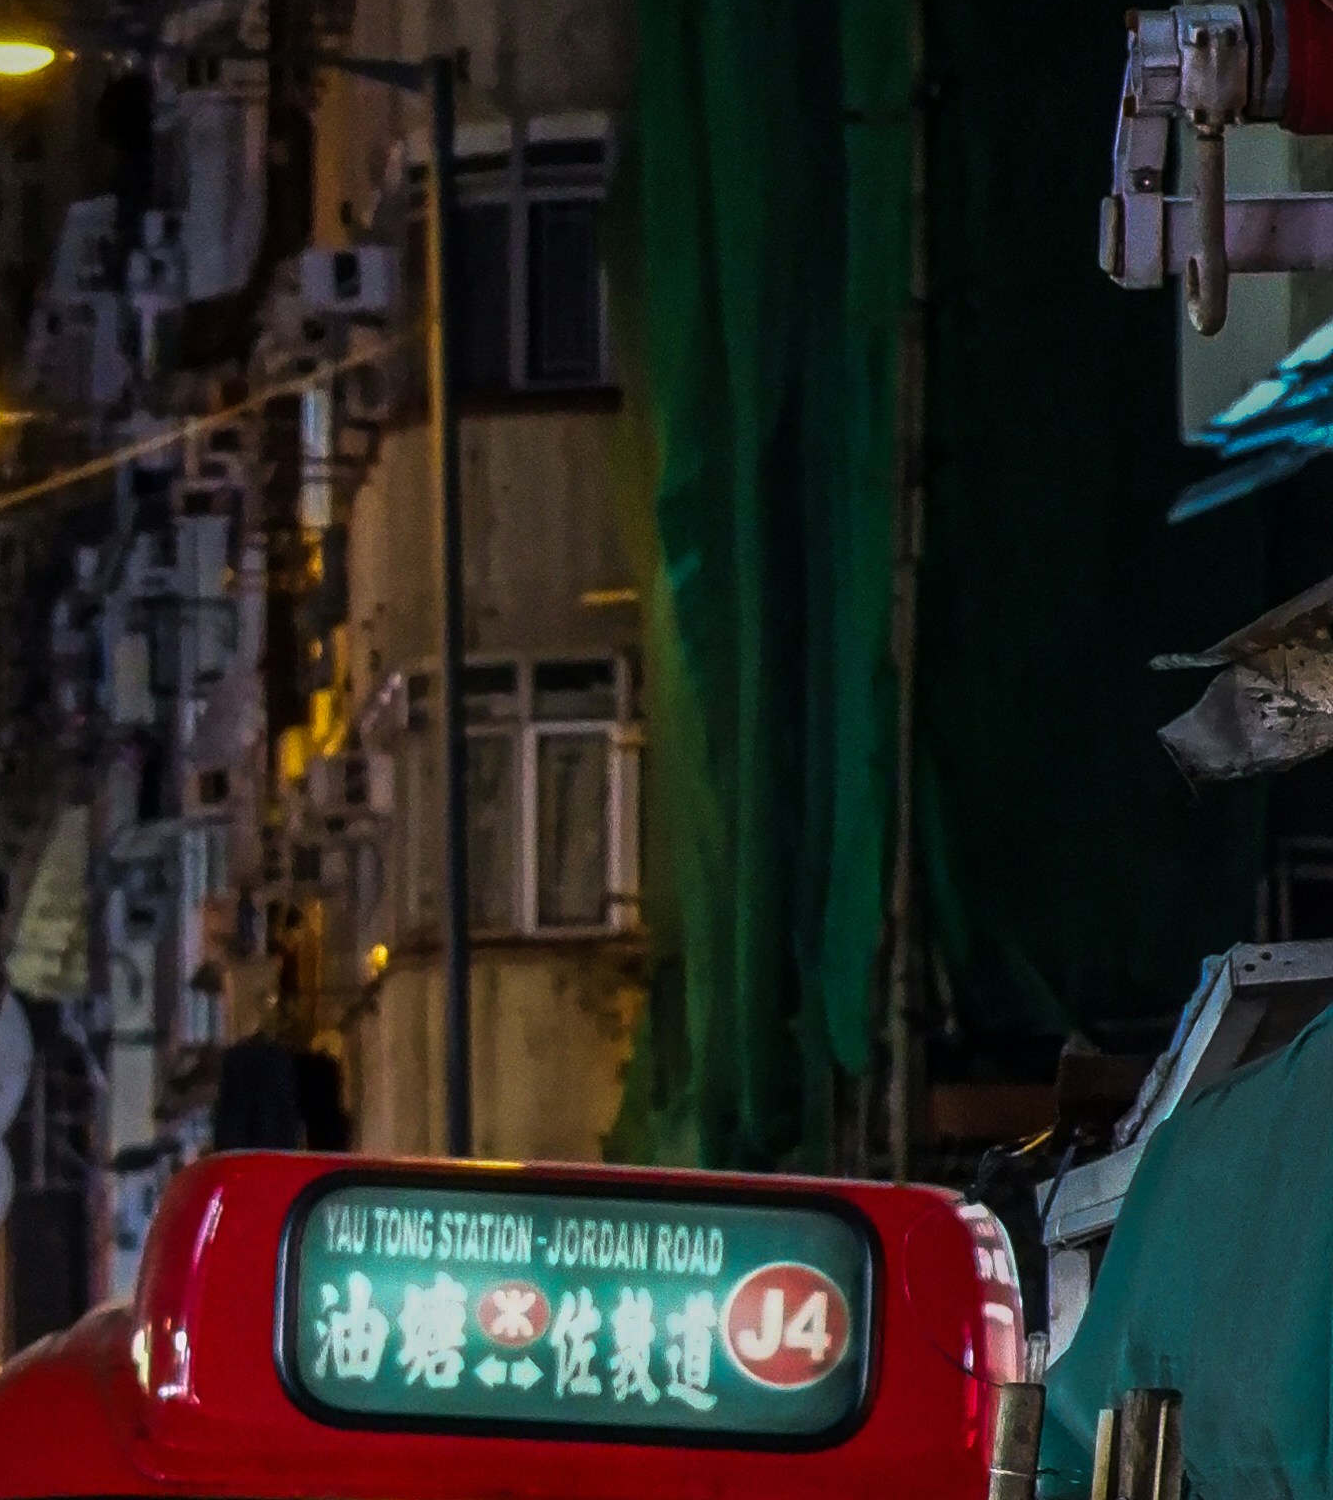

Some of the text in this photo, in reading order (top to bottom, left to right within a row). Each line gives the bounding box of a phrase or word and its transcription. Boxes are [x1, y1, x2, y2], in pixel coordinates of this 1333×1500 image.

[326, 1206, 367, 1254] YAU
[373, 1206, 434, 1259] TONG
[438, 1211, 532, 1265] STATION
[655, 1223, 725, 1275] ROAD
[737, 1286, 833, 1363] J4
